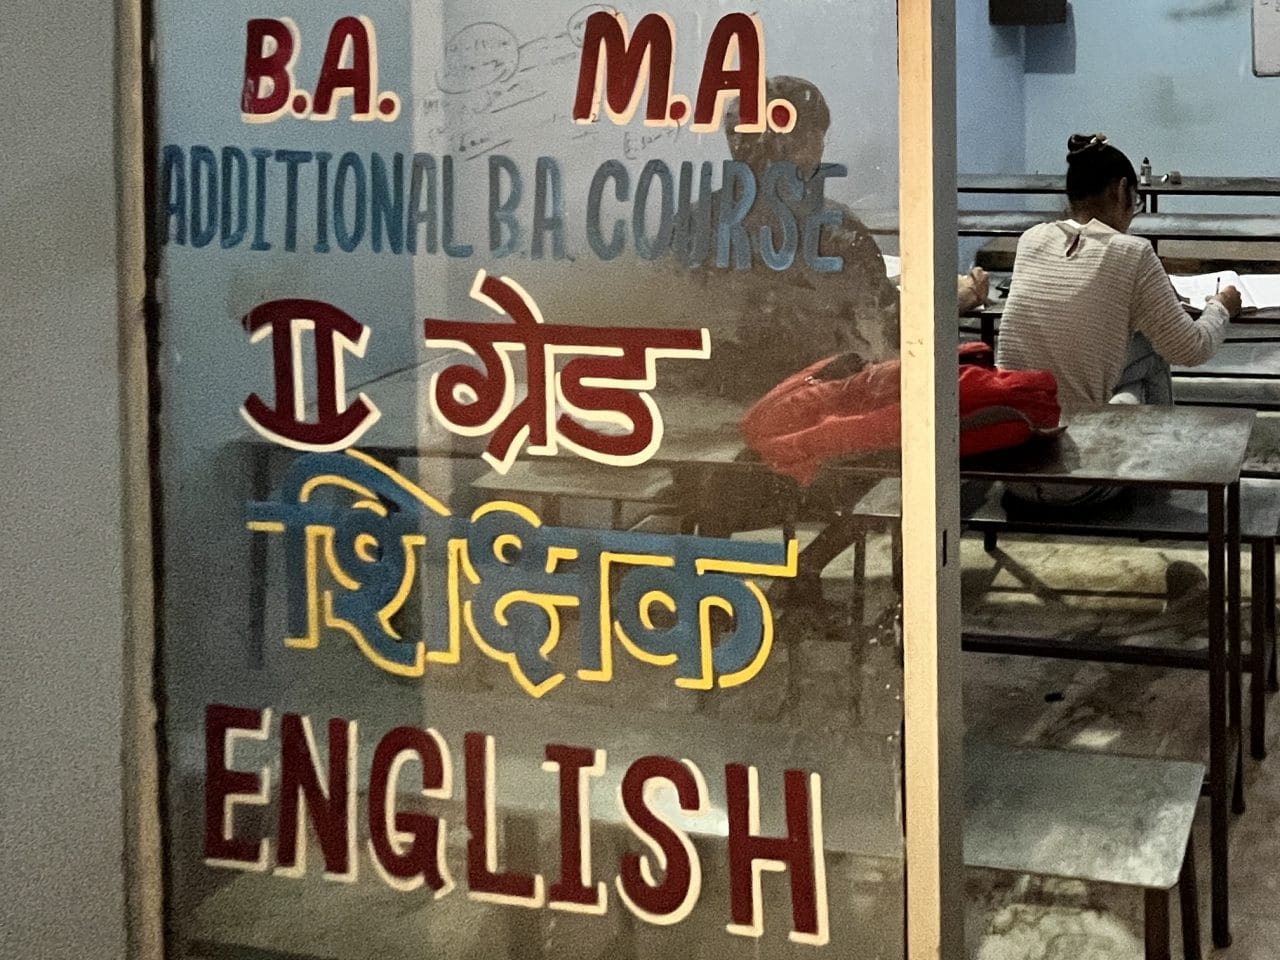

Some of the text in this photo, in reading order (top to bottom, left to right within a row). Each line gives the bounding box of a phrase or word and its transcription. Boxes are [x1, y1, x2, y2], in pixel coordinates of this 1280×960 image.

[242, 16, 400, 123] B.A.
[572, 9, 797, 134] M.A.
[160, 142, 473, 259] ADDITIONAL
[586, 159, 849, 273] COURSE
[424, 269, 711, 472] ग्रेड
[204, 703, 830, 945] ENGLISH
